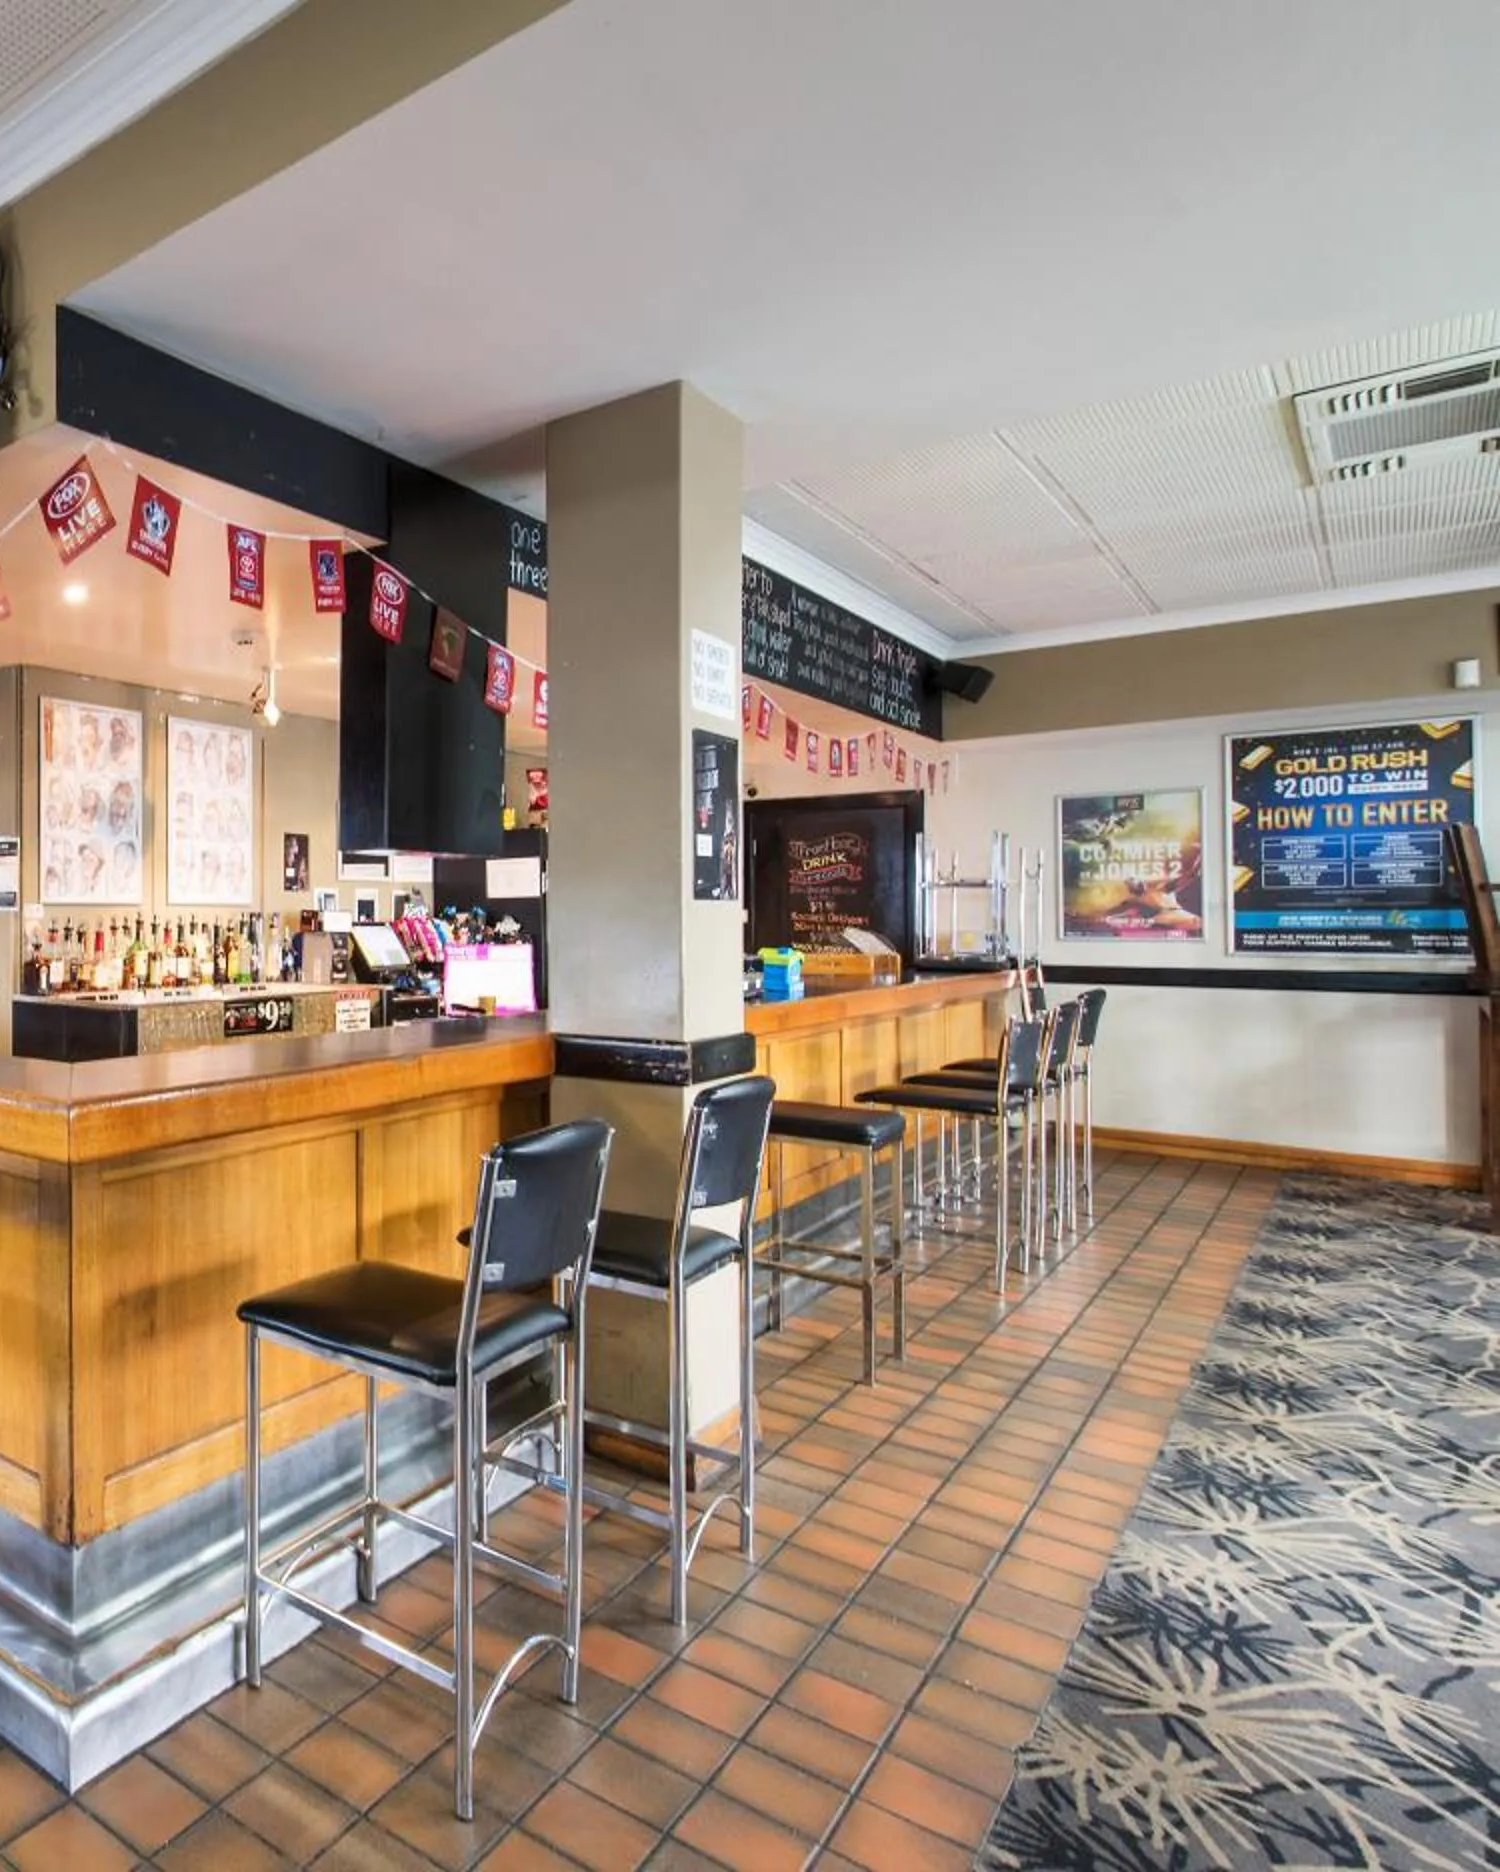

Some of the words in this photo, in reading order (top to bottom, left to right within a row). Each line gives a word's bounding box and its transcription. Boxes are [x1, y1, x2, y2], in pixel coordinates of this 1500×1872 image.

[57, 497, 101, 541] LIVE
[373, 596, 400, 625] LIVE
[869, 691, 885, 715] and
[1275, 754, 1347, 776] GOLD
[1350, 749, 1428, 771] RUSH
[1348, 772, 1376, 784] TO
[1385, 769, 1428, 781] WIN
[1257, 806, 1313, 831] HOW
[1322, 803, 1353, 828] TO
[1363, 799, 1449, 826] ENTER
[802, 852, 848, 872] DRINK
[1093, 862, 1165, 882] JONES
[1168, 861, 1184, 880] 2
